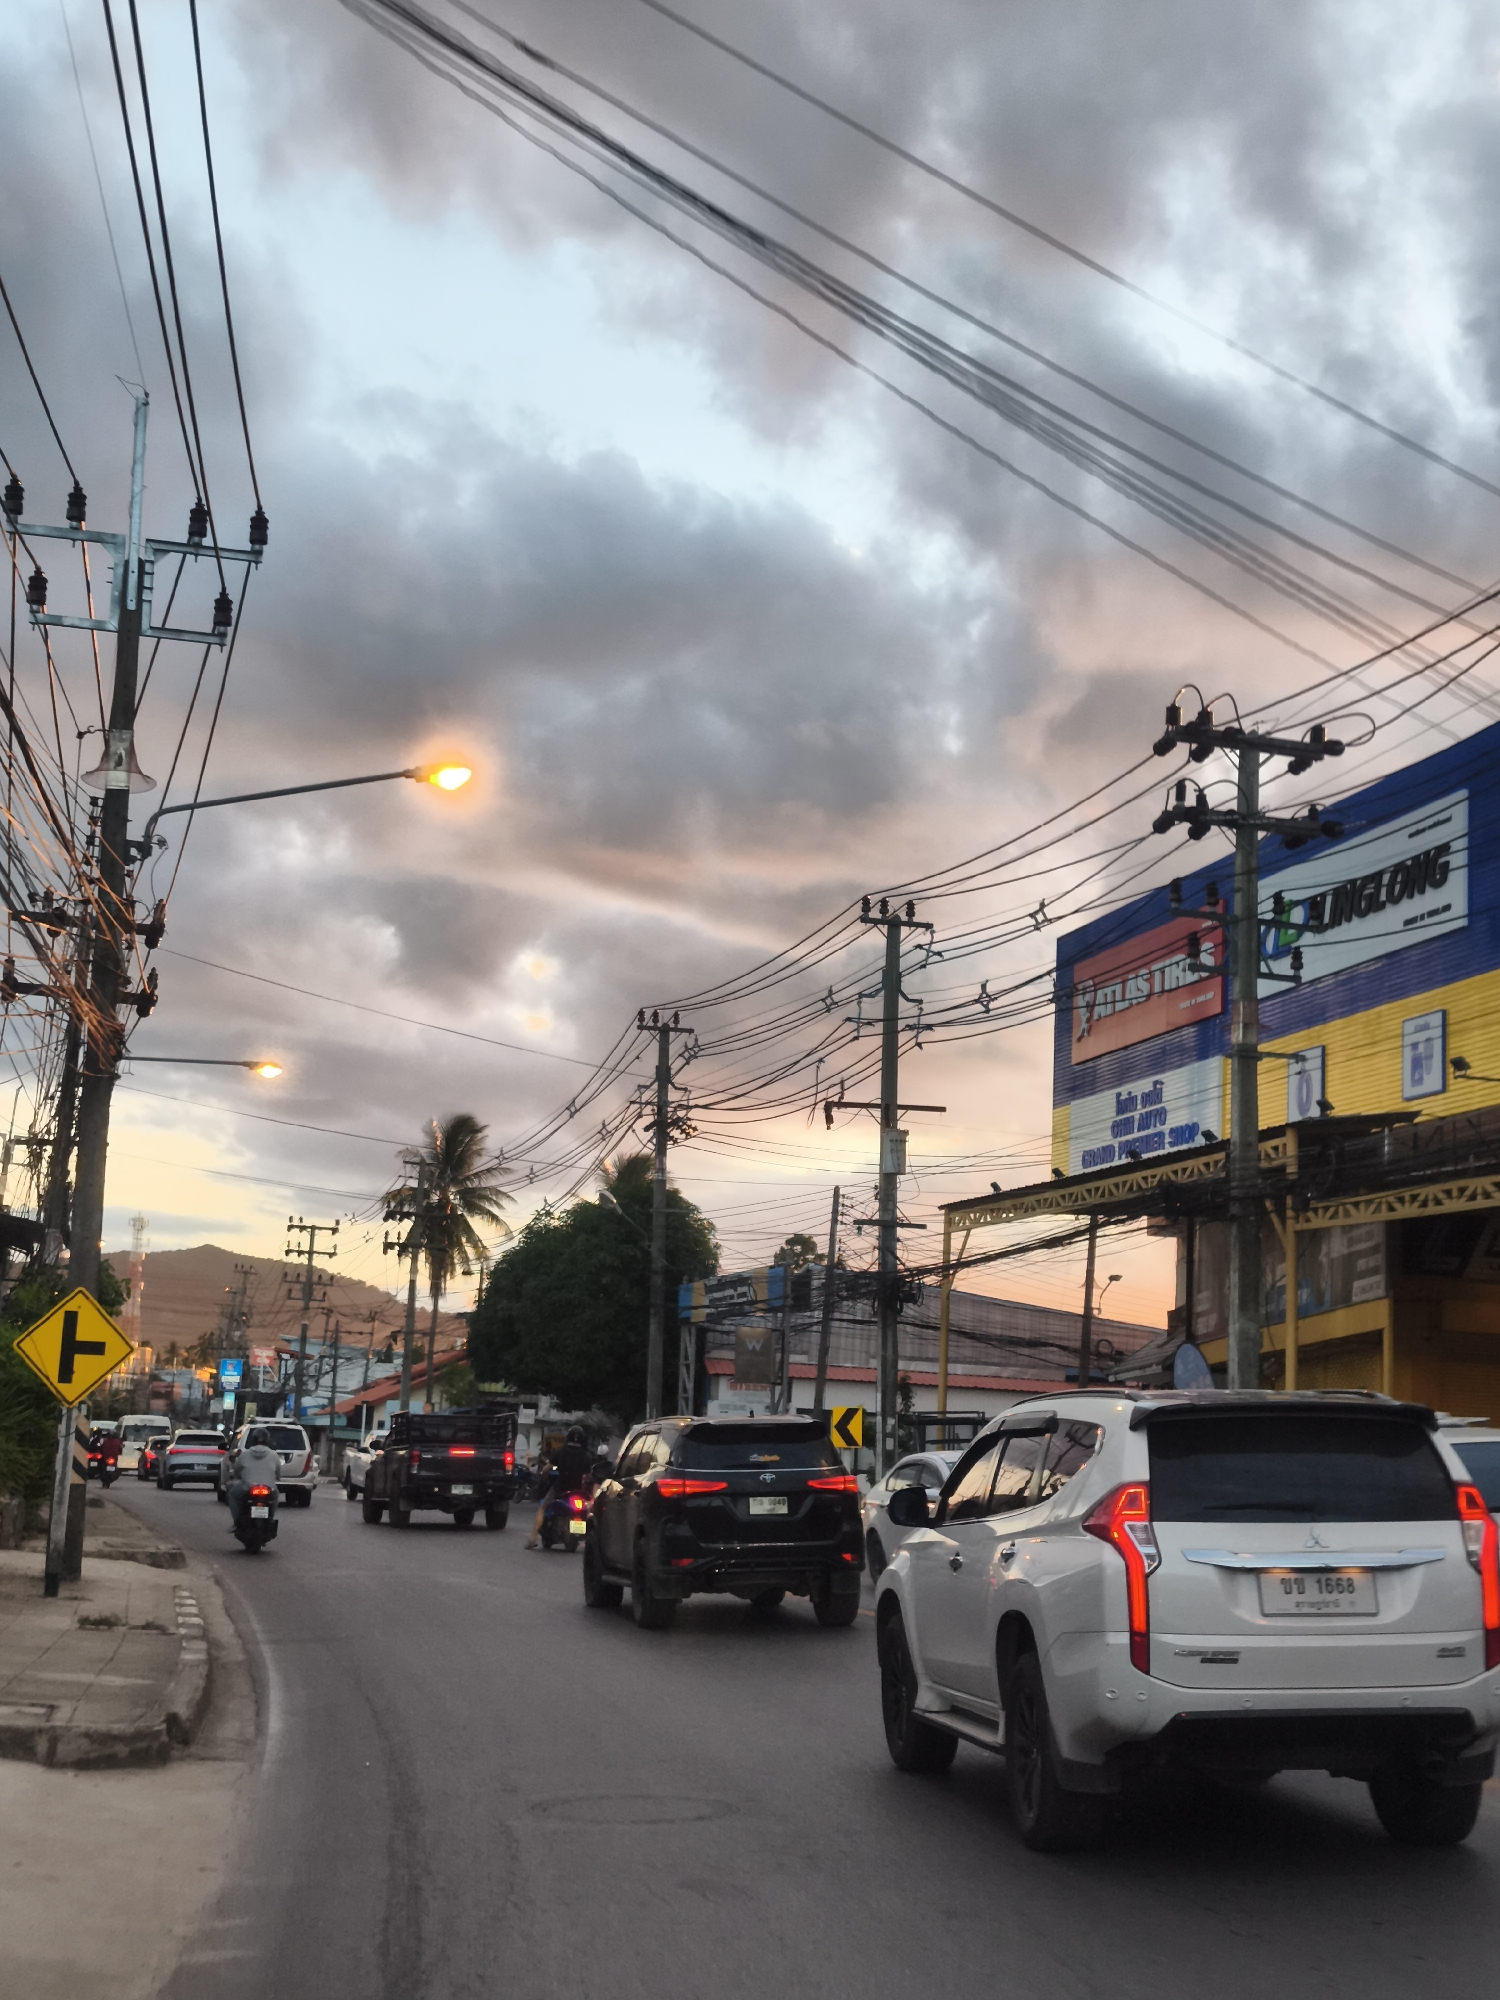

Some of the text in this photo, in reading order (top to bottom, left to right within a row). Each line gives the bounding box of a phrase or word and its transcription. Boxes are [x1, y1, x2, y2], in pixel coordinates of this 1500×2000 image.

[1312, 843, 1451, 934] LINGLONG
[1093, 968, 1150, 1021] ATLAS
[1137, 1106, 1167, 1132] AUTO
[1082, 1122, 1199, 1169] GRAND PREMIER SHOP
[1316, 1577, 1356, 1595] 1668
